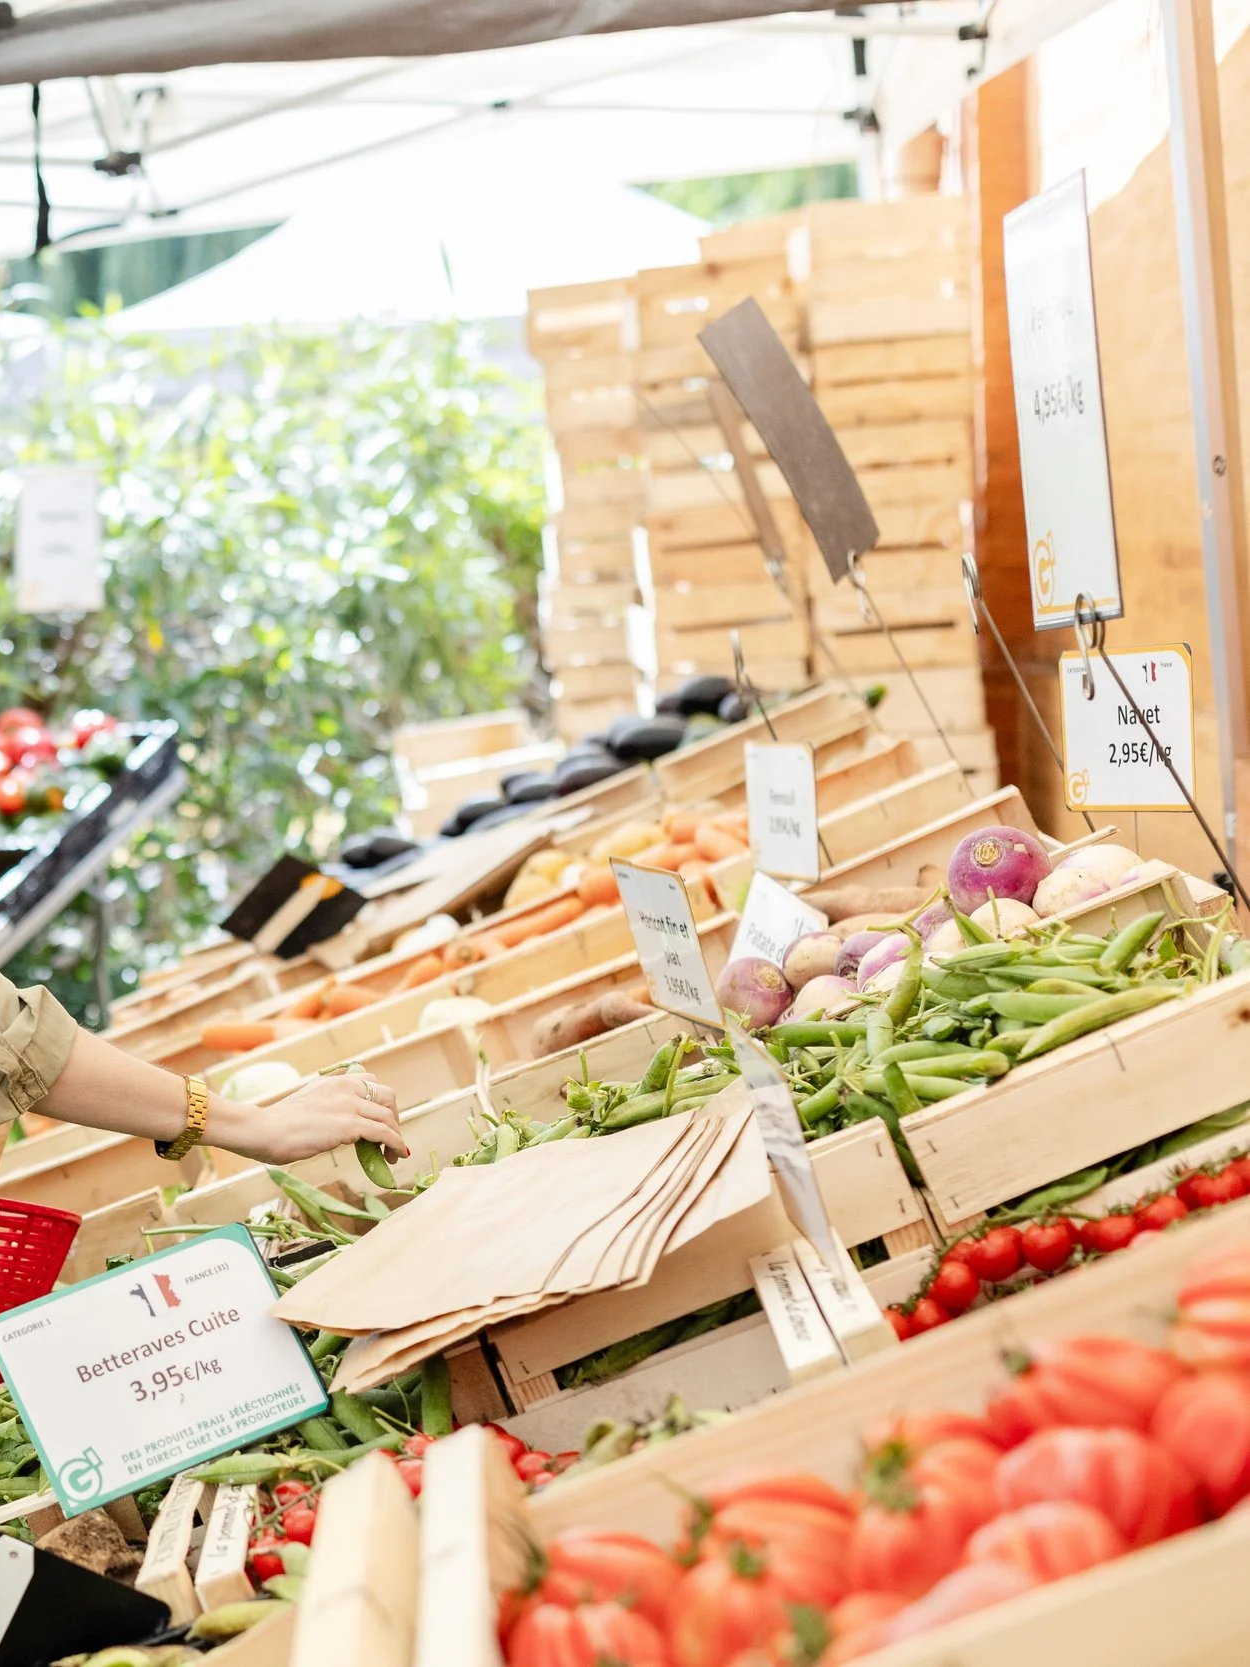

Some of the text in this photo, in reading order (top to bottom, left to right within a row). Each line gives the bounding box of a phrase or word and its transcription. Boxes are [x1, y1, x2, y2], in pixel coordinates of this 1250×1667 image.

[746, 921, 776, 958] Patate
[185, 1262, 230, 1284] FRANCE (31)
[76, 1307, 240, 1383] Betteraves Cuite
[129, 1358, 222, 1402] 3,95€/kg
[122, 1449, 141, 1463] DES
[144, 1427, 194, 1453] PRODUITS
[198, 1414, 226, 1432] FRAIS
[127, 1394, 306, 1474] EN DIRECT CHEZ LES PRODUCTEURS
